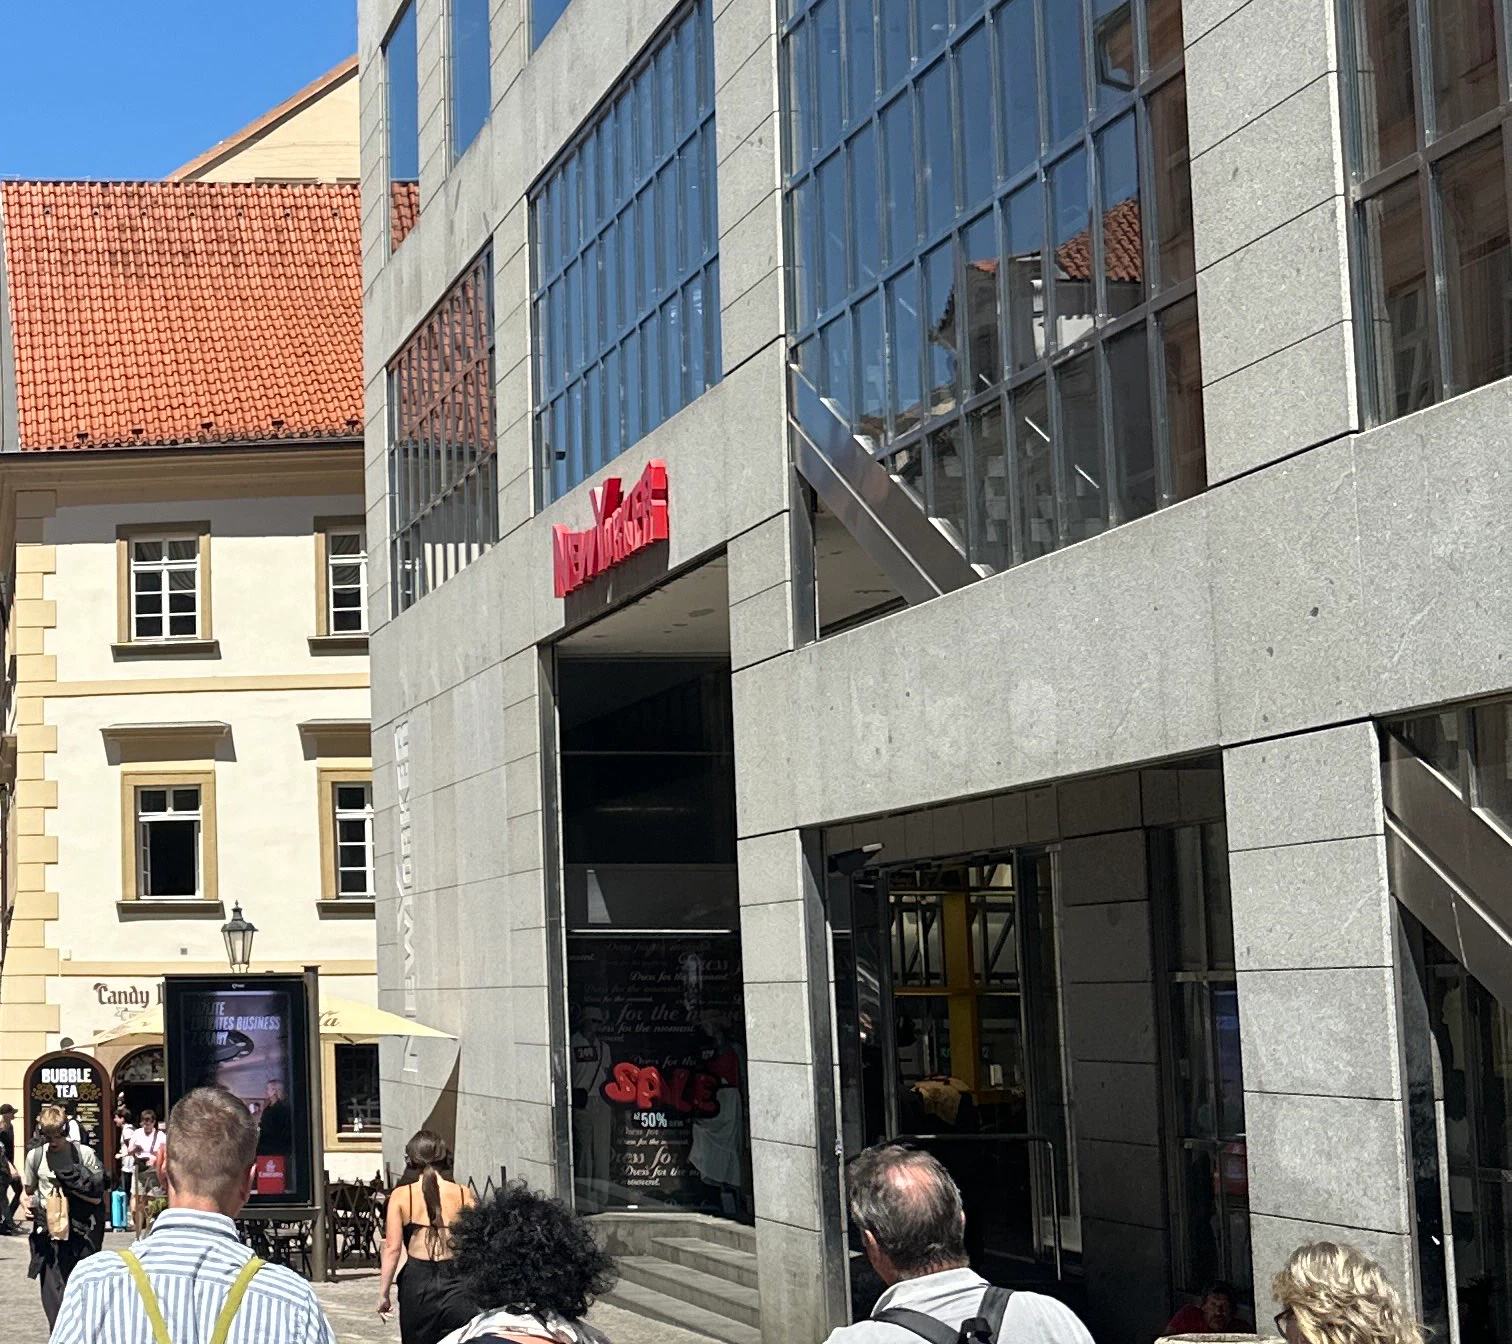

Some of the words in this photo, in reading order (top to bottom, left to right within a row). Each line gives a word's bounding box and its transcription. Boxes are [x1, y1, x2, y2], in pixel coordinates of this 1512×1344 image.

[93, 983, 150, 1009] Candy
[236, 1015, 282, 1031] BUSINESS
[41, 1068, 92, 1083] BUBBLE
[55, 1084, 78, 1099] TEA
[604, 1062, 721, 1113] SALE
[640, 1112, 668, 1128] 50%
